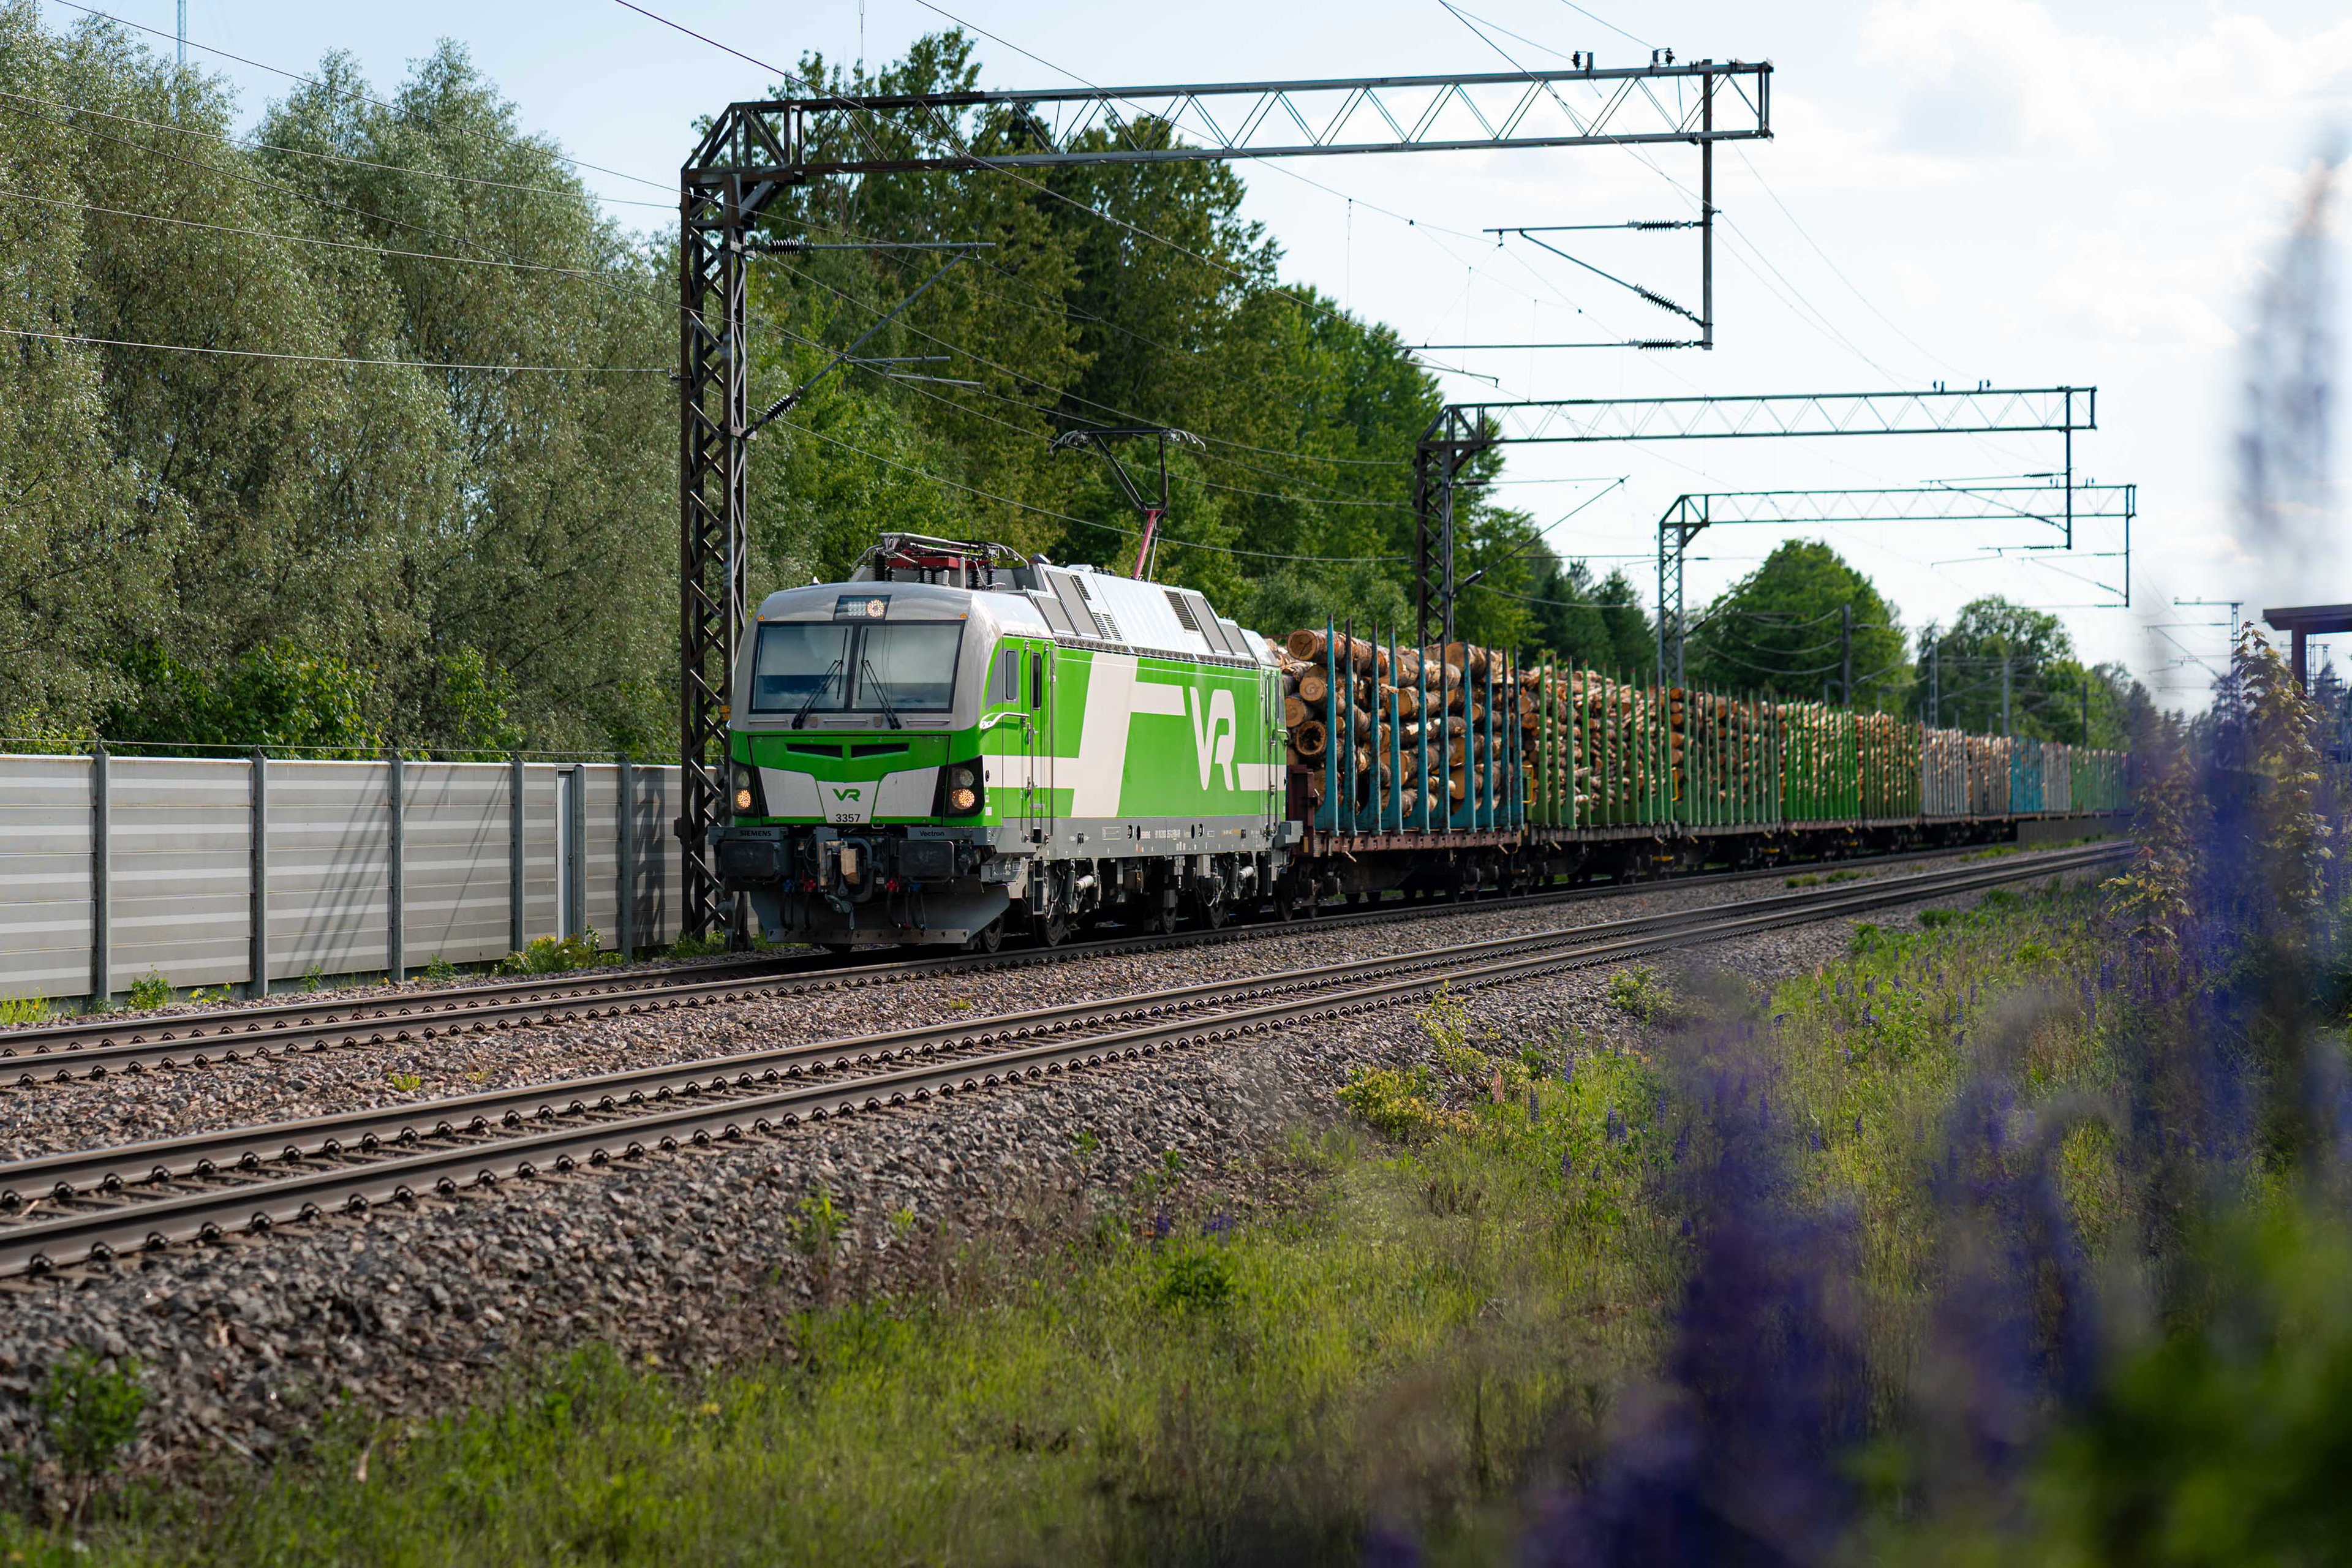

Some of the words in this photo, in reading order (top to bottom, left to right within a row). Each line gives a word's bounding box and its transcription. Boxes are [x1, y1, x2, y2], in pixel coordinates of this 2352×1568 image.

[1189, 686, 1236, 791] VR
[832, 788, 861, 802] VR
[835, 813, 861, 823] 3357
